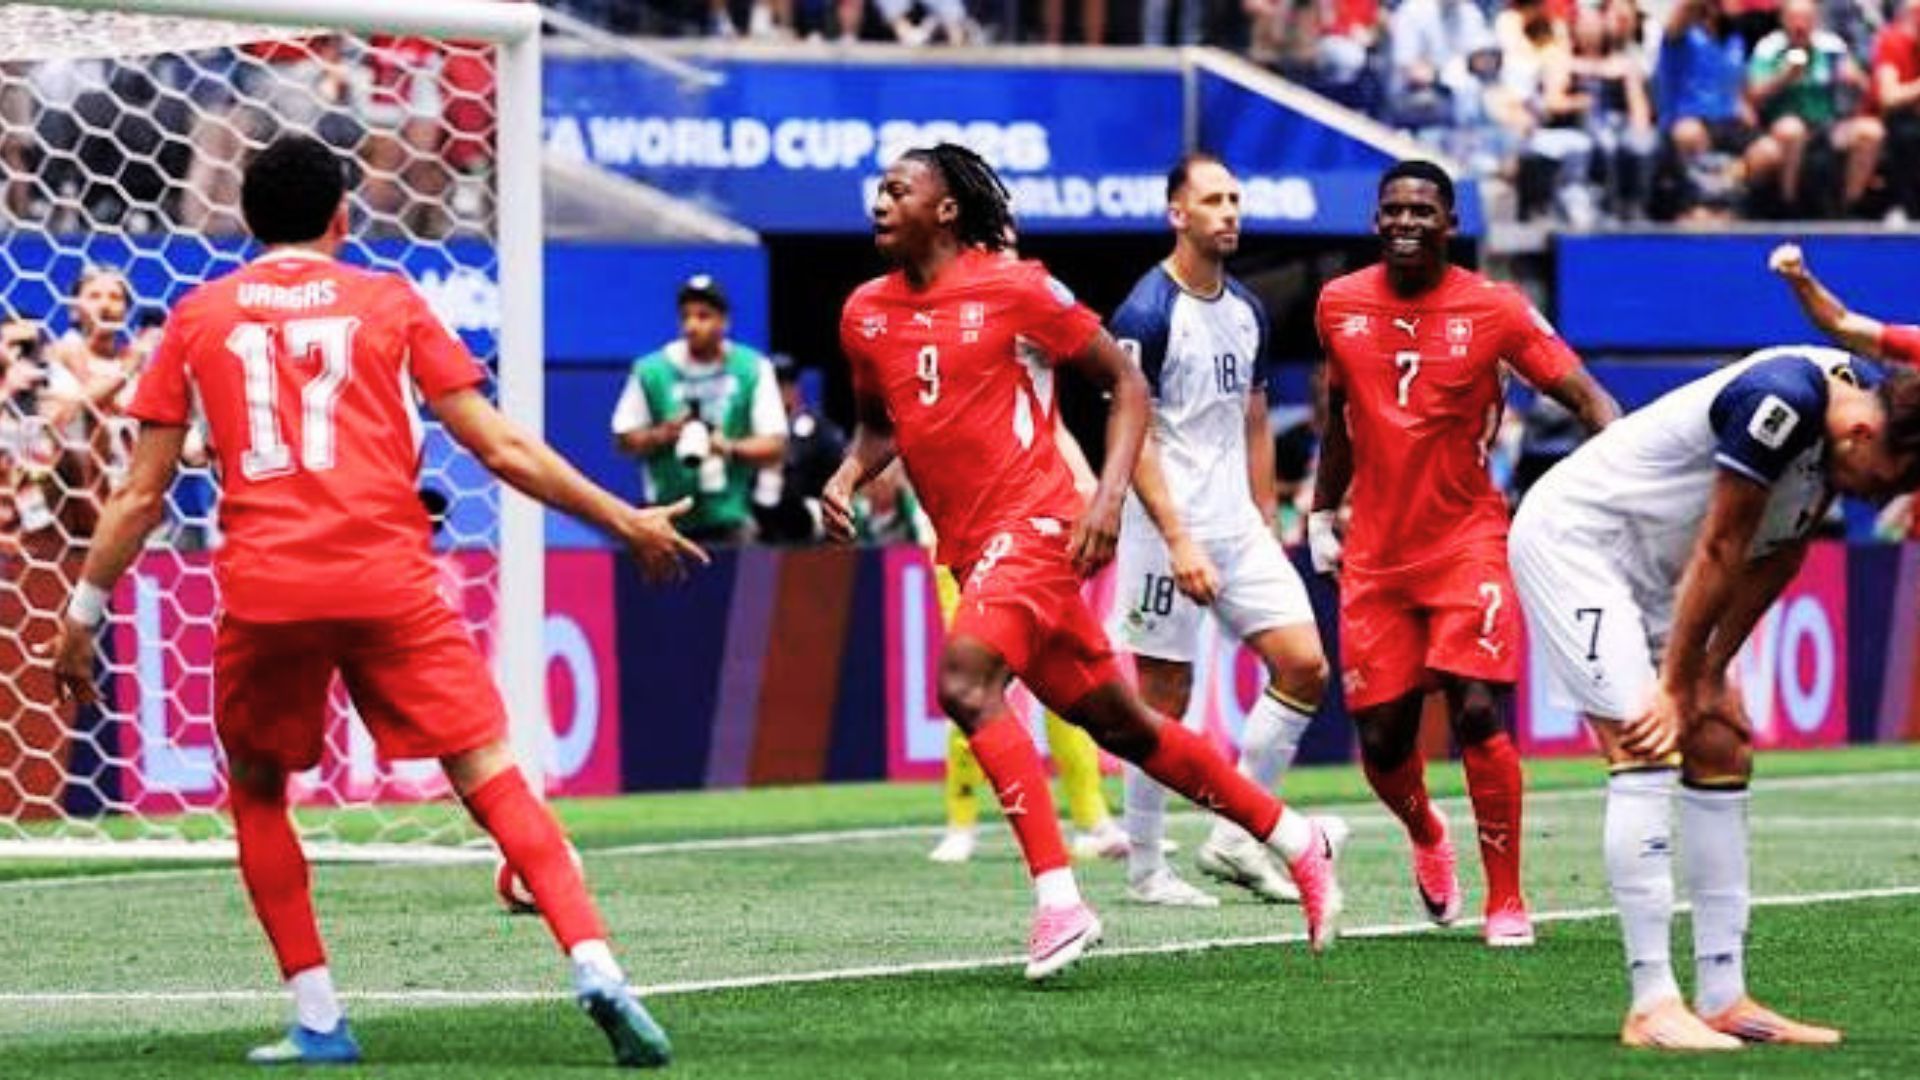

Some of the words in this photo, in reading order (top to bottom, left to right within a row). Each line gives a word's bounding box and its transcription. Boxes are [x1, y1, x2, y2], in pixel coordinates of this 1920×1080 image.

[587, 117, 772, 169] WORLD
[773, 118, 873, 169] CUP
[236, 280, 338, 308] VARGAS
[225, 316, 362, 481] 17
[916, 344, 941, 406] 9
[1214, 353, 1238, 395] 18
[1395, 350, 1421, 408] 7
[974, 531, 1014, 572] 9
[1141, 573, 1175, 616] 18
[1478, 582, 1502, 636] 7
[1576, 607, 1604, 662] 7
